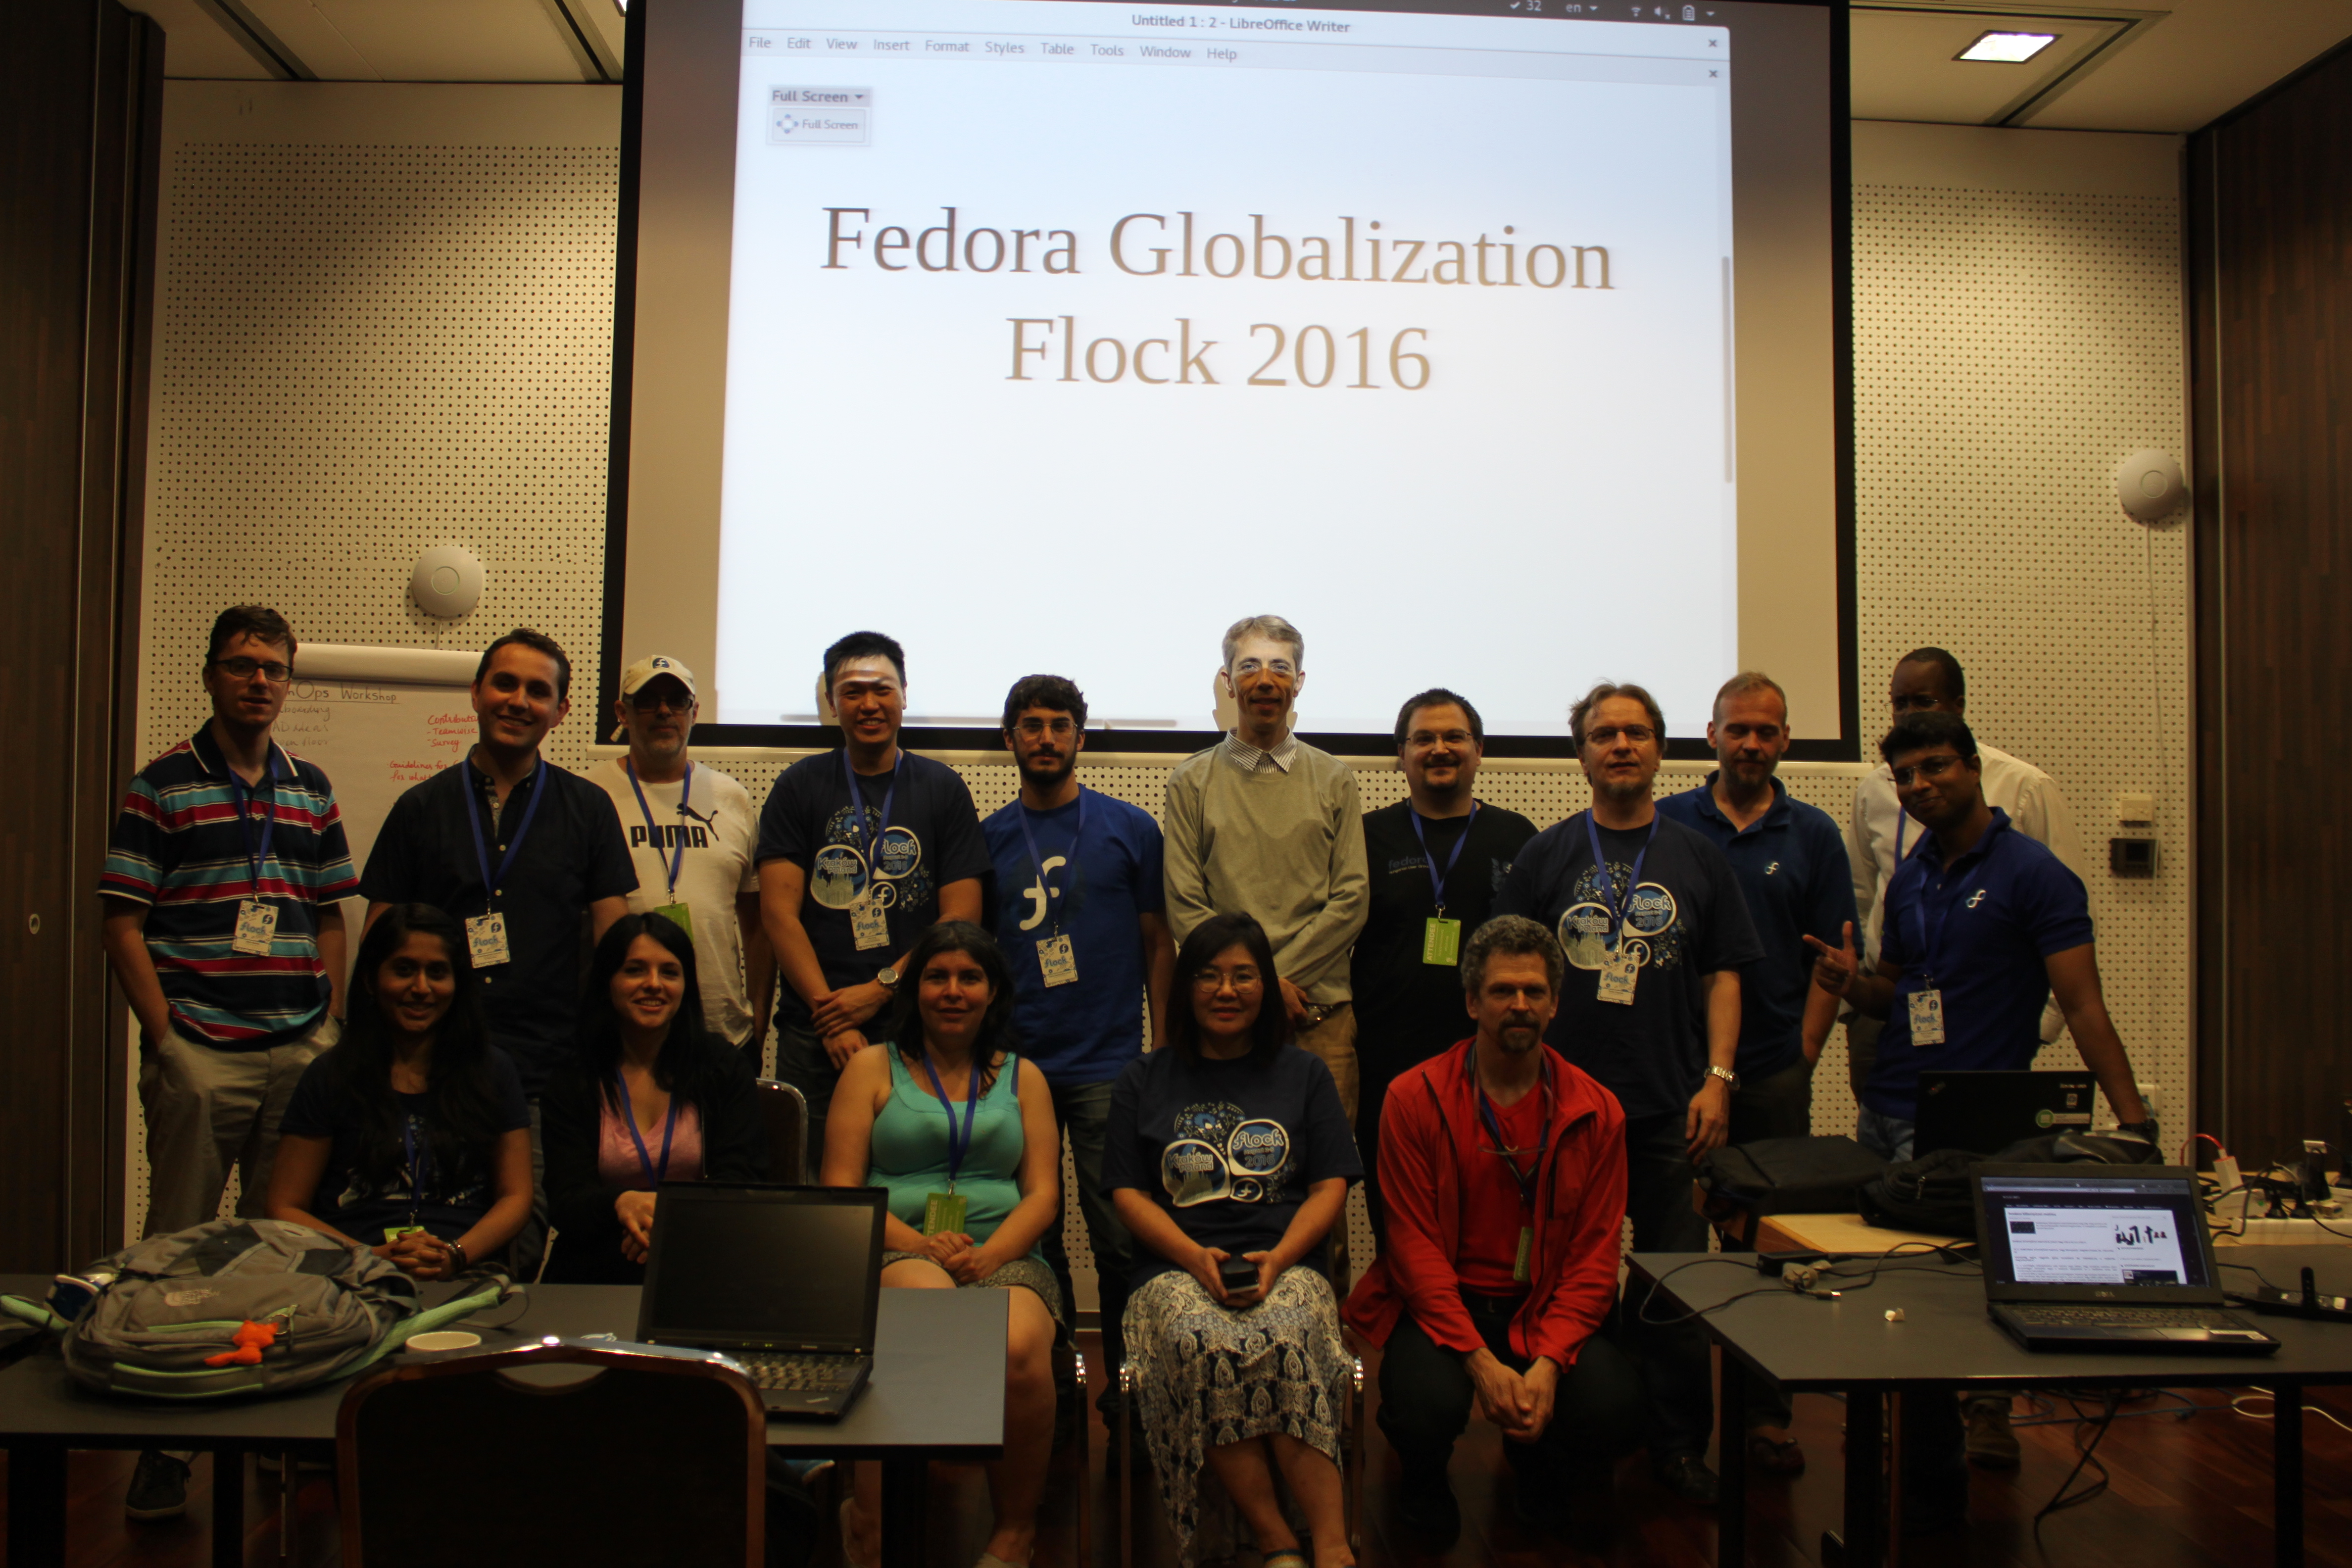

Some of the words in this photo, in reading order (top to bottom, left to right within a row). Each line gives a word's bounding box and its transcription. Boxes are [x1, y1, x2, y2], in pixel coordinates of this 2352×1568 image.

[1566, 4, 1581, 13] en
[1132, 14, 1184, 27] Untitled
[1189, 16, 1196, 27] 1
[1208, 17, 1217, 28] 2
[1229, 18, 1303, 31] LibreOffice
[1307, 20, 1351, 33] Writer
[748, 37, 771, 49] File
[787, 37, 811, 49] Edit
[826, 38, 858, 50] View
[874, 39, 910, 51] Insert
[925, 40, 970, 52] Format
[984, 41, 1025, 55] Styles
[1041, 43, 1075, 55] Table
[1090, 44, 1124, 56] Tools
[1139, 45, 1192, 58] Window
[1207, 47, 1237, 62] Help
[772, 90, 797, 102] Full
[802, 91, 849, 102] Screen
[802, 119, 822, 129] Full
[824, 119, 859, 130] Screen
[820, 206, 1082, 275] Fedora
[1109, 210, 1615, 290] Globalization
[1004, 315, 1220, 385] Flock
[1247, 322, 1431, 391] 2016
[341, 682, 396, 704] Workshop
[431, 738, 459, 753] Survey
[390, 760, 433, 770] Guidelines
[630, 825, 709, 848] PUMA
[818, 856, 857, 870] Kraków
[883, 861, 908, 871] 2016
[828, 866, 858, 875] Poland
[856, 919, 880, 931] flock
[1567, 915, 1610, 930] Kraków
[1578, 924, 1610, 933] Poland
[1635, 916, 1664, 928] 2016
[472, 935, 499, 948] flock
[1426, 923, 1436, 961] ATTENDEE
[1044, 956, 1067, 968] flock
[1604, 972, 1630, 984] flock
[1232, 1128, 1284, 1150] flock
[1167, 1151, 1214, 1169] Kraków
[1244, 1154, 1276, 1168] 2016
[1178, 1163, 1214, 1174] Poland
